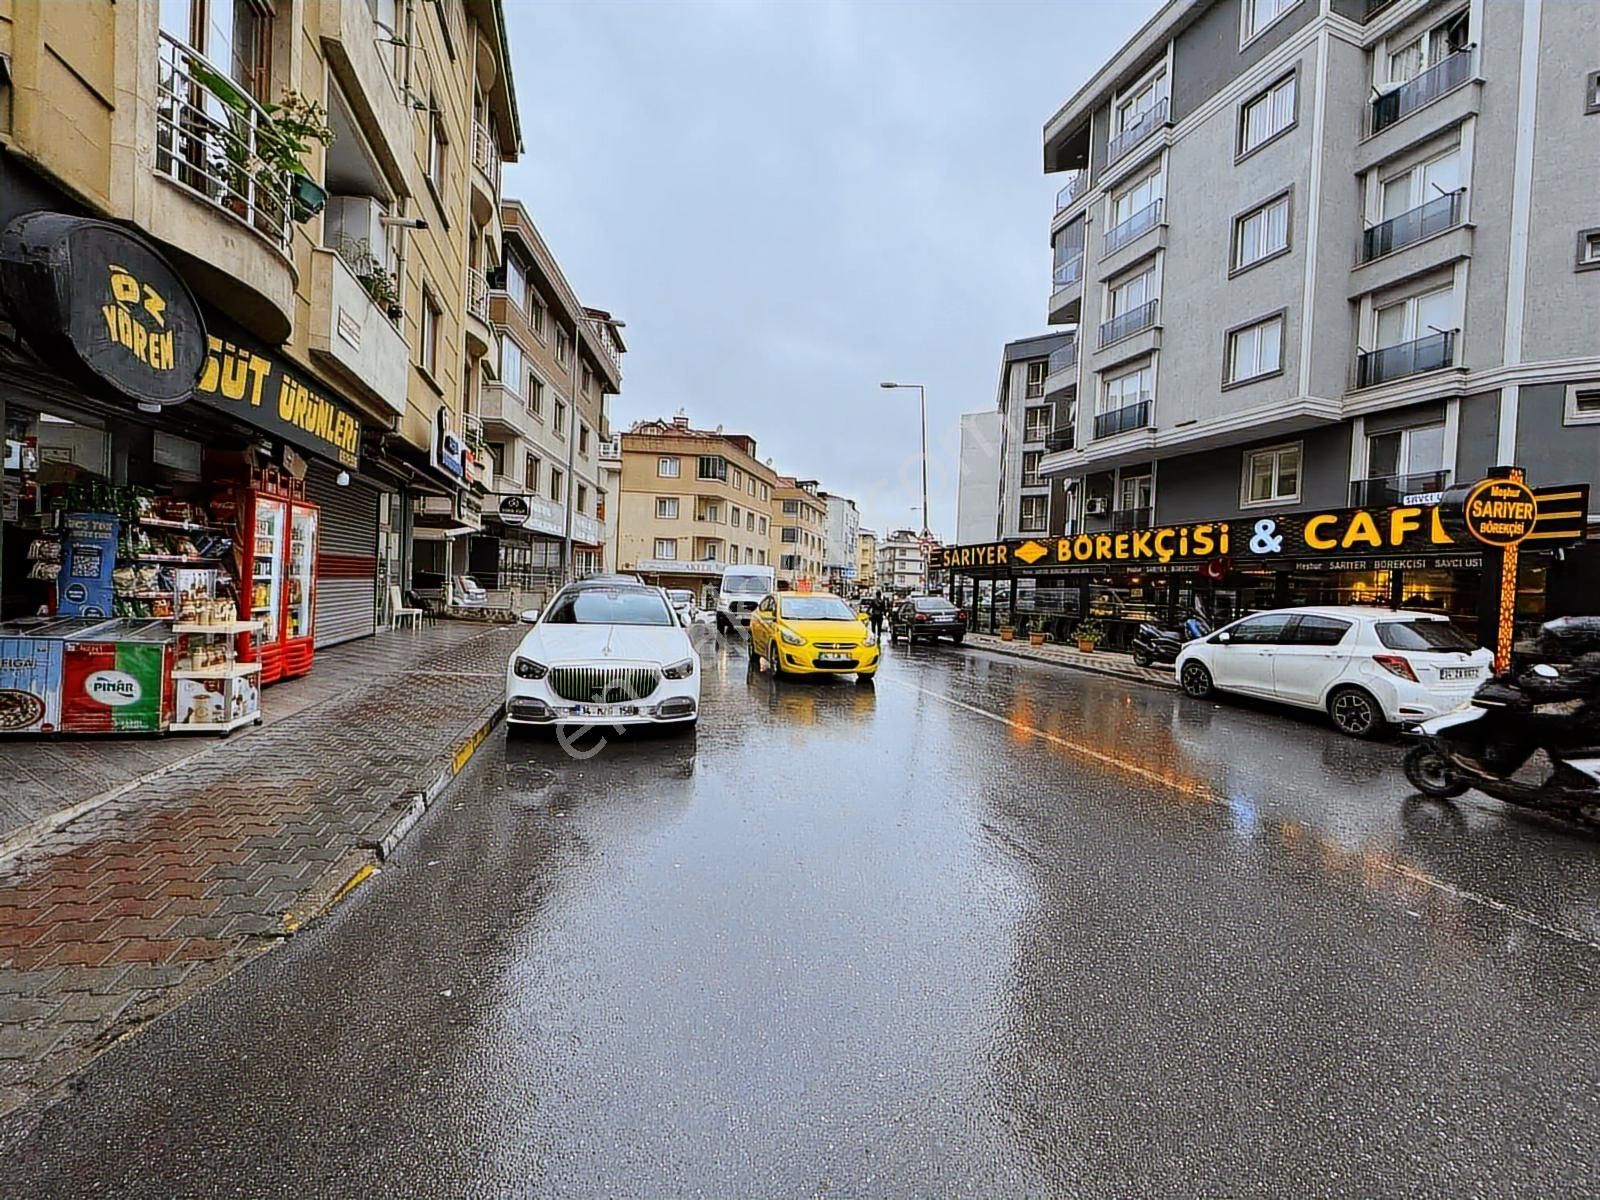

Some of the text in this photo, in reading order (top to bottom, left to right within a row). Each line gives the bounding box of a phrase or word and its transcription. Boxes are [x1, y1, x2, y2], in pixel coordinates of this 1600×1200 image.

[1472, 500, 1533, 519] SARIYER
[943, 545, 1007, 567] SARIYER
[1057, 523, 1230, 563] BÖREKÇİSİ
[1249, 519, 1283, 554] &
